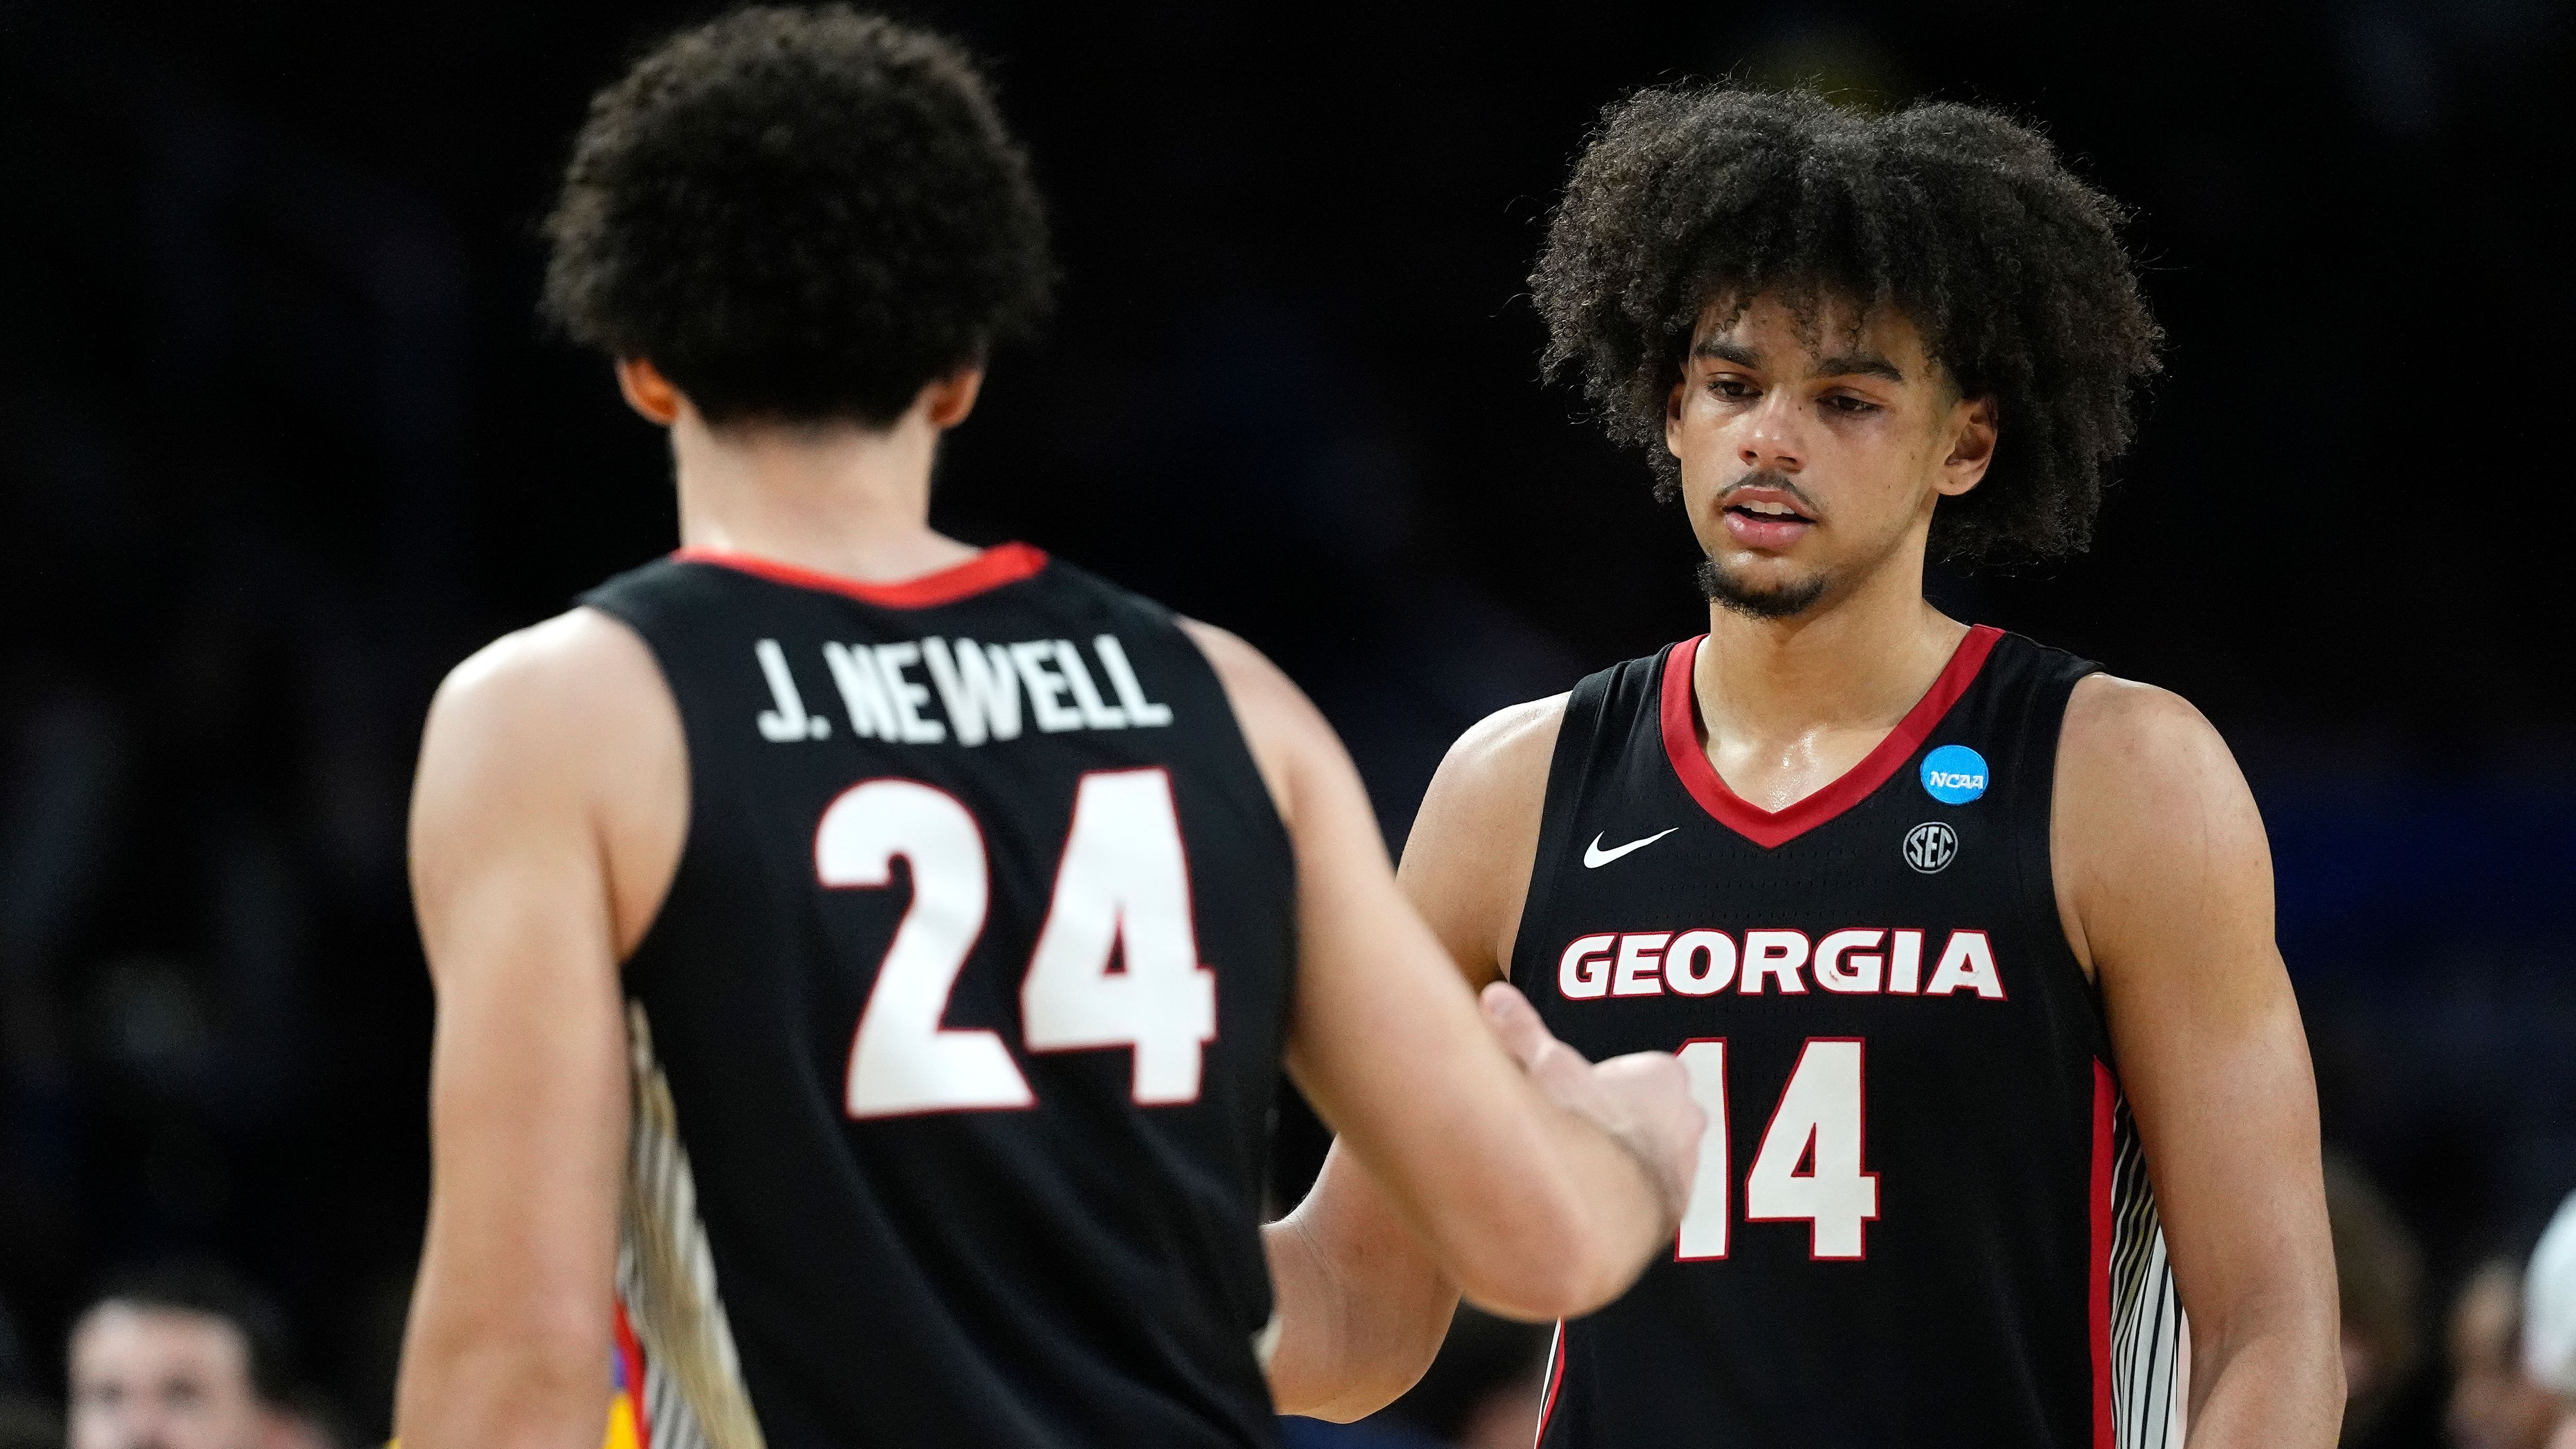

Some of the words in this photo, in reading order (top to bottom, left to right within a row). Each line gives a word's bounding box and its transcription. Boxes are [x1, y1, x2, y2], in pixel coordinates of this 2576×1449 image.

[755, 638, 830, 742] J.
[824, 634, 1174, 747] NEWELL
[1930, 771, 1984, 790] NCAA
[1909, 826, 1953, 868] SEC
[813, 765, 1217, 1121] 24
[1557, 928, 2008, 1001] GEORGIA
[1672, 1036, 1881, 1262] 14
